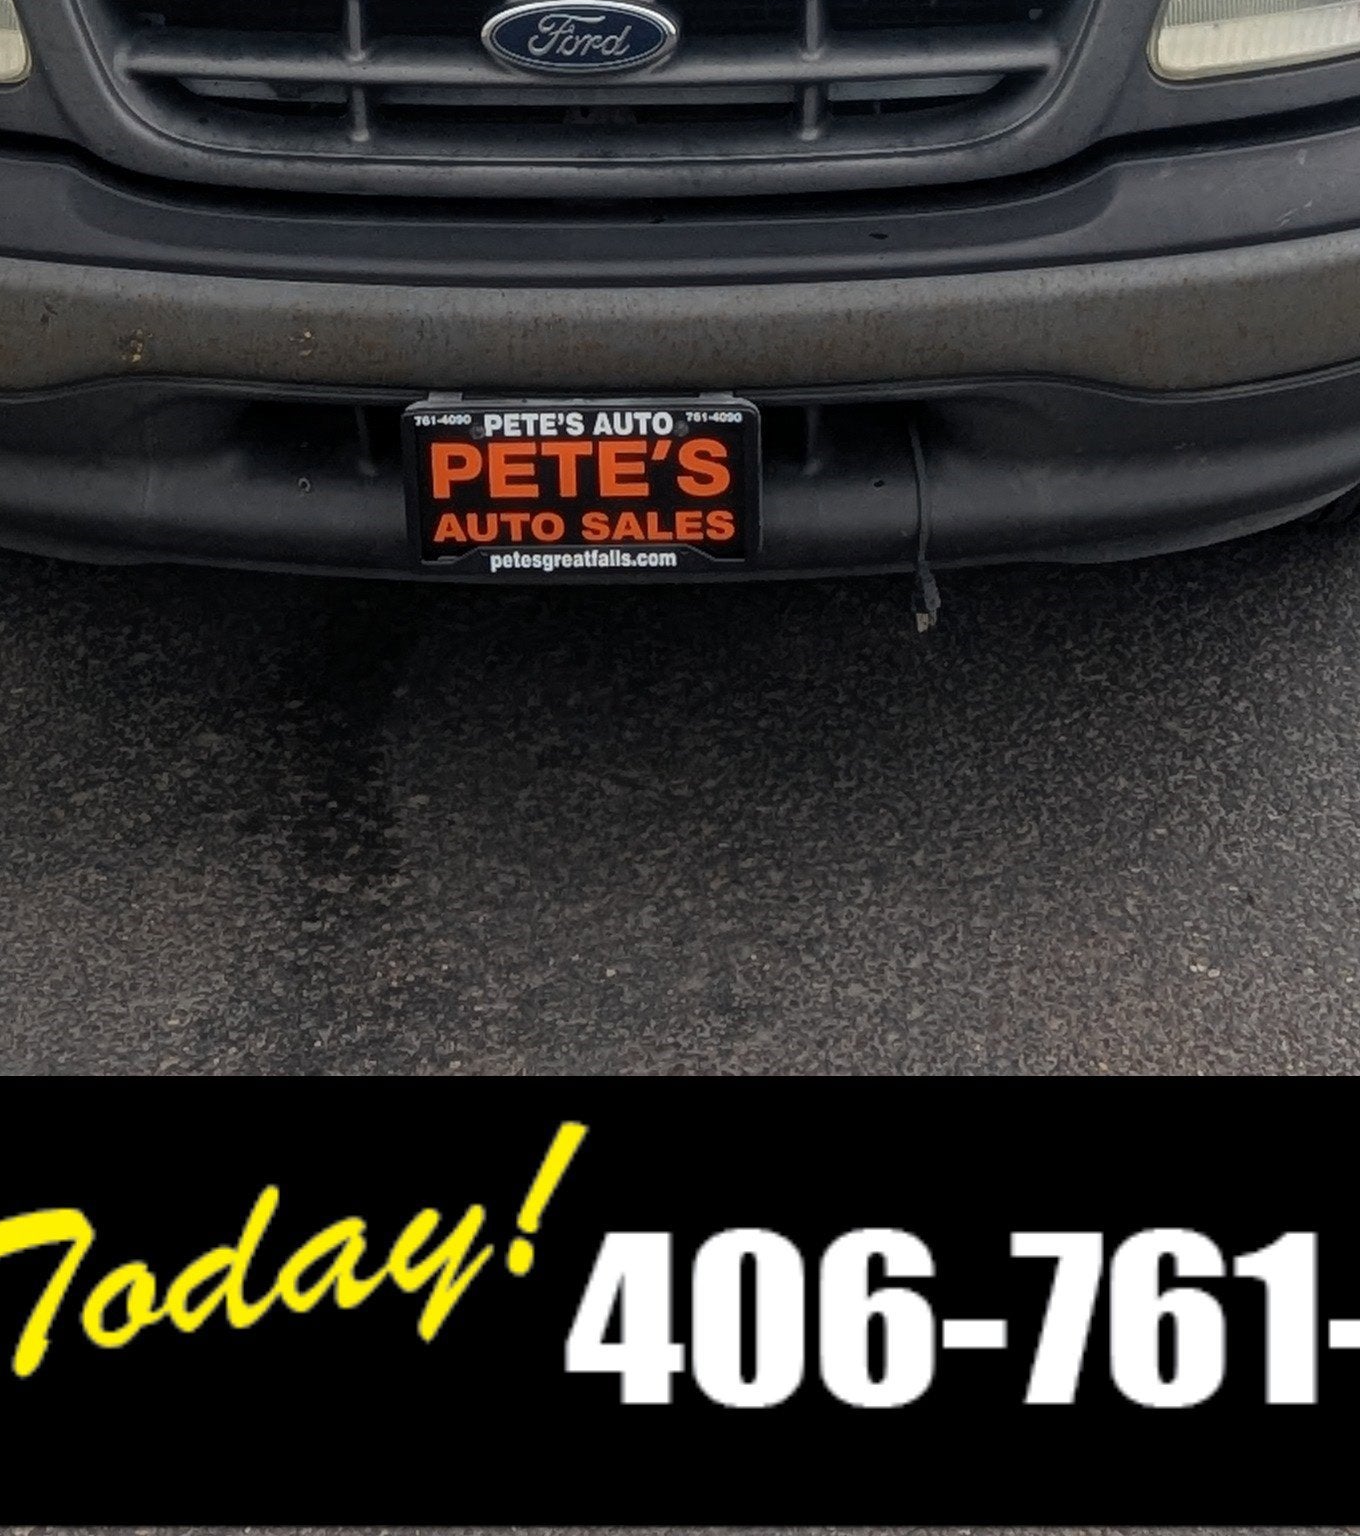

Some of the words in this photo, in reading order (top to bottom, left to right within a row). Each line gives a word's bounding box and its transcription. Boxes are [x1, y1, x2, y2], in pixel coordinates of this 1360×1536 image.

[527, 13, 633, 57] Ford
[414, 414, 472, 427] 761-4090
[484, 413, 585, 437] PETE'S
[593, 411, 674, 436] AUTO
[685, 412, 743, 424] 761-4090
[430, 438, 732, 500] PETE'S
[433, 512, 566, 543] AUTO
[580, 510, 736, 541] SALES
[490, 549, 678, 572] petesgreatfalls.com
